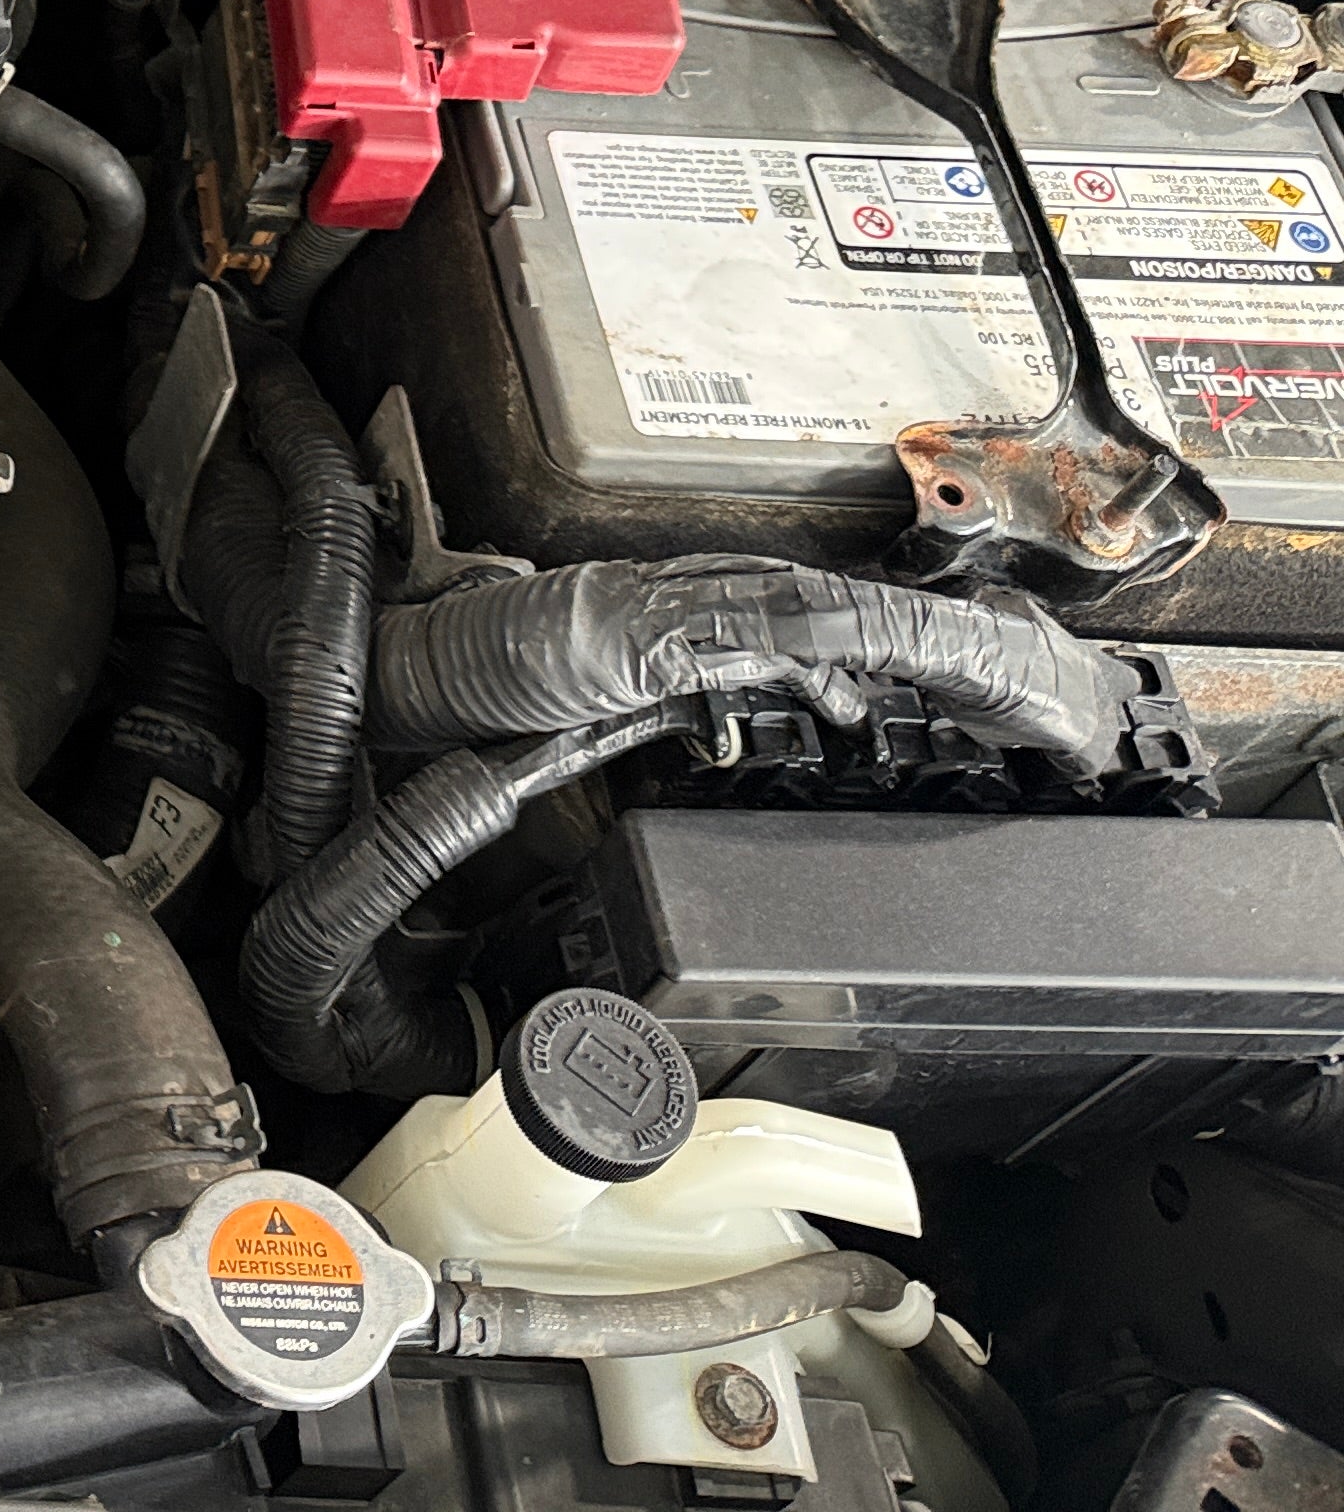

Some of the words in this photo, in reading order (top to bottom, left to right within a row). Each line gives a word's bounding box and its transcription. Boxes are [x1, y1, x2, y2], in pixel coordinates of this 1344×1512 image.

[1177, 176, 1208, 185] HELP
[1210, 177, 1258, 186] MEDICAL
[1231, 187, 1264, 196] WITH
[1204, 196, 1231, 204] EYES
[1233, 197, 1269, 206] FLUSH
[940, 233, 968, 242] ACID
[1116, 227, 1140, 236] CAN
[1142, 227, 1183, 238] GASES
[1185, 229, 1252, 240] EXPLOSIVE
[1224, 241, 1266, 252] SHIELD
[885, 252, 905, 263] OR
[907, 253, 930, 264] TIP
[932, 253, 961, 265] NOT
[961, 254, 982, 266] DO
[1128, 260, 1313, 282] DANGER/POISON
[978, 332, 1004, 345] 100
[1154, 356, 1215, 372] PLUS
[640, 411, 748, 426] REPLACEMENT
[750, 415, 787, 427] FREE
[791, 416, 871, 430] 18-MONTH
[149, 794, 181, 838] F3
[236, 1239, 328, 1257] WARNING
[218, 1260, 352, 1278] AVERTISSEMENT
[222, 1282, 259, 1294] NEVER
[260, 1284, 293, 1295] OPEN
[294, 1284, 328, 1297] WHEN
[221, 1296, 234, 1307] NE
[235, 1297, 273, 1309] JAMAIS
